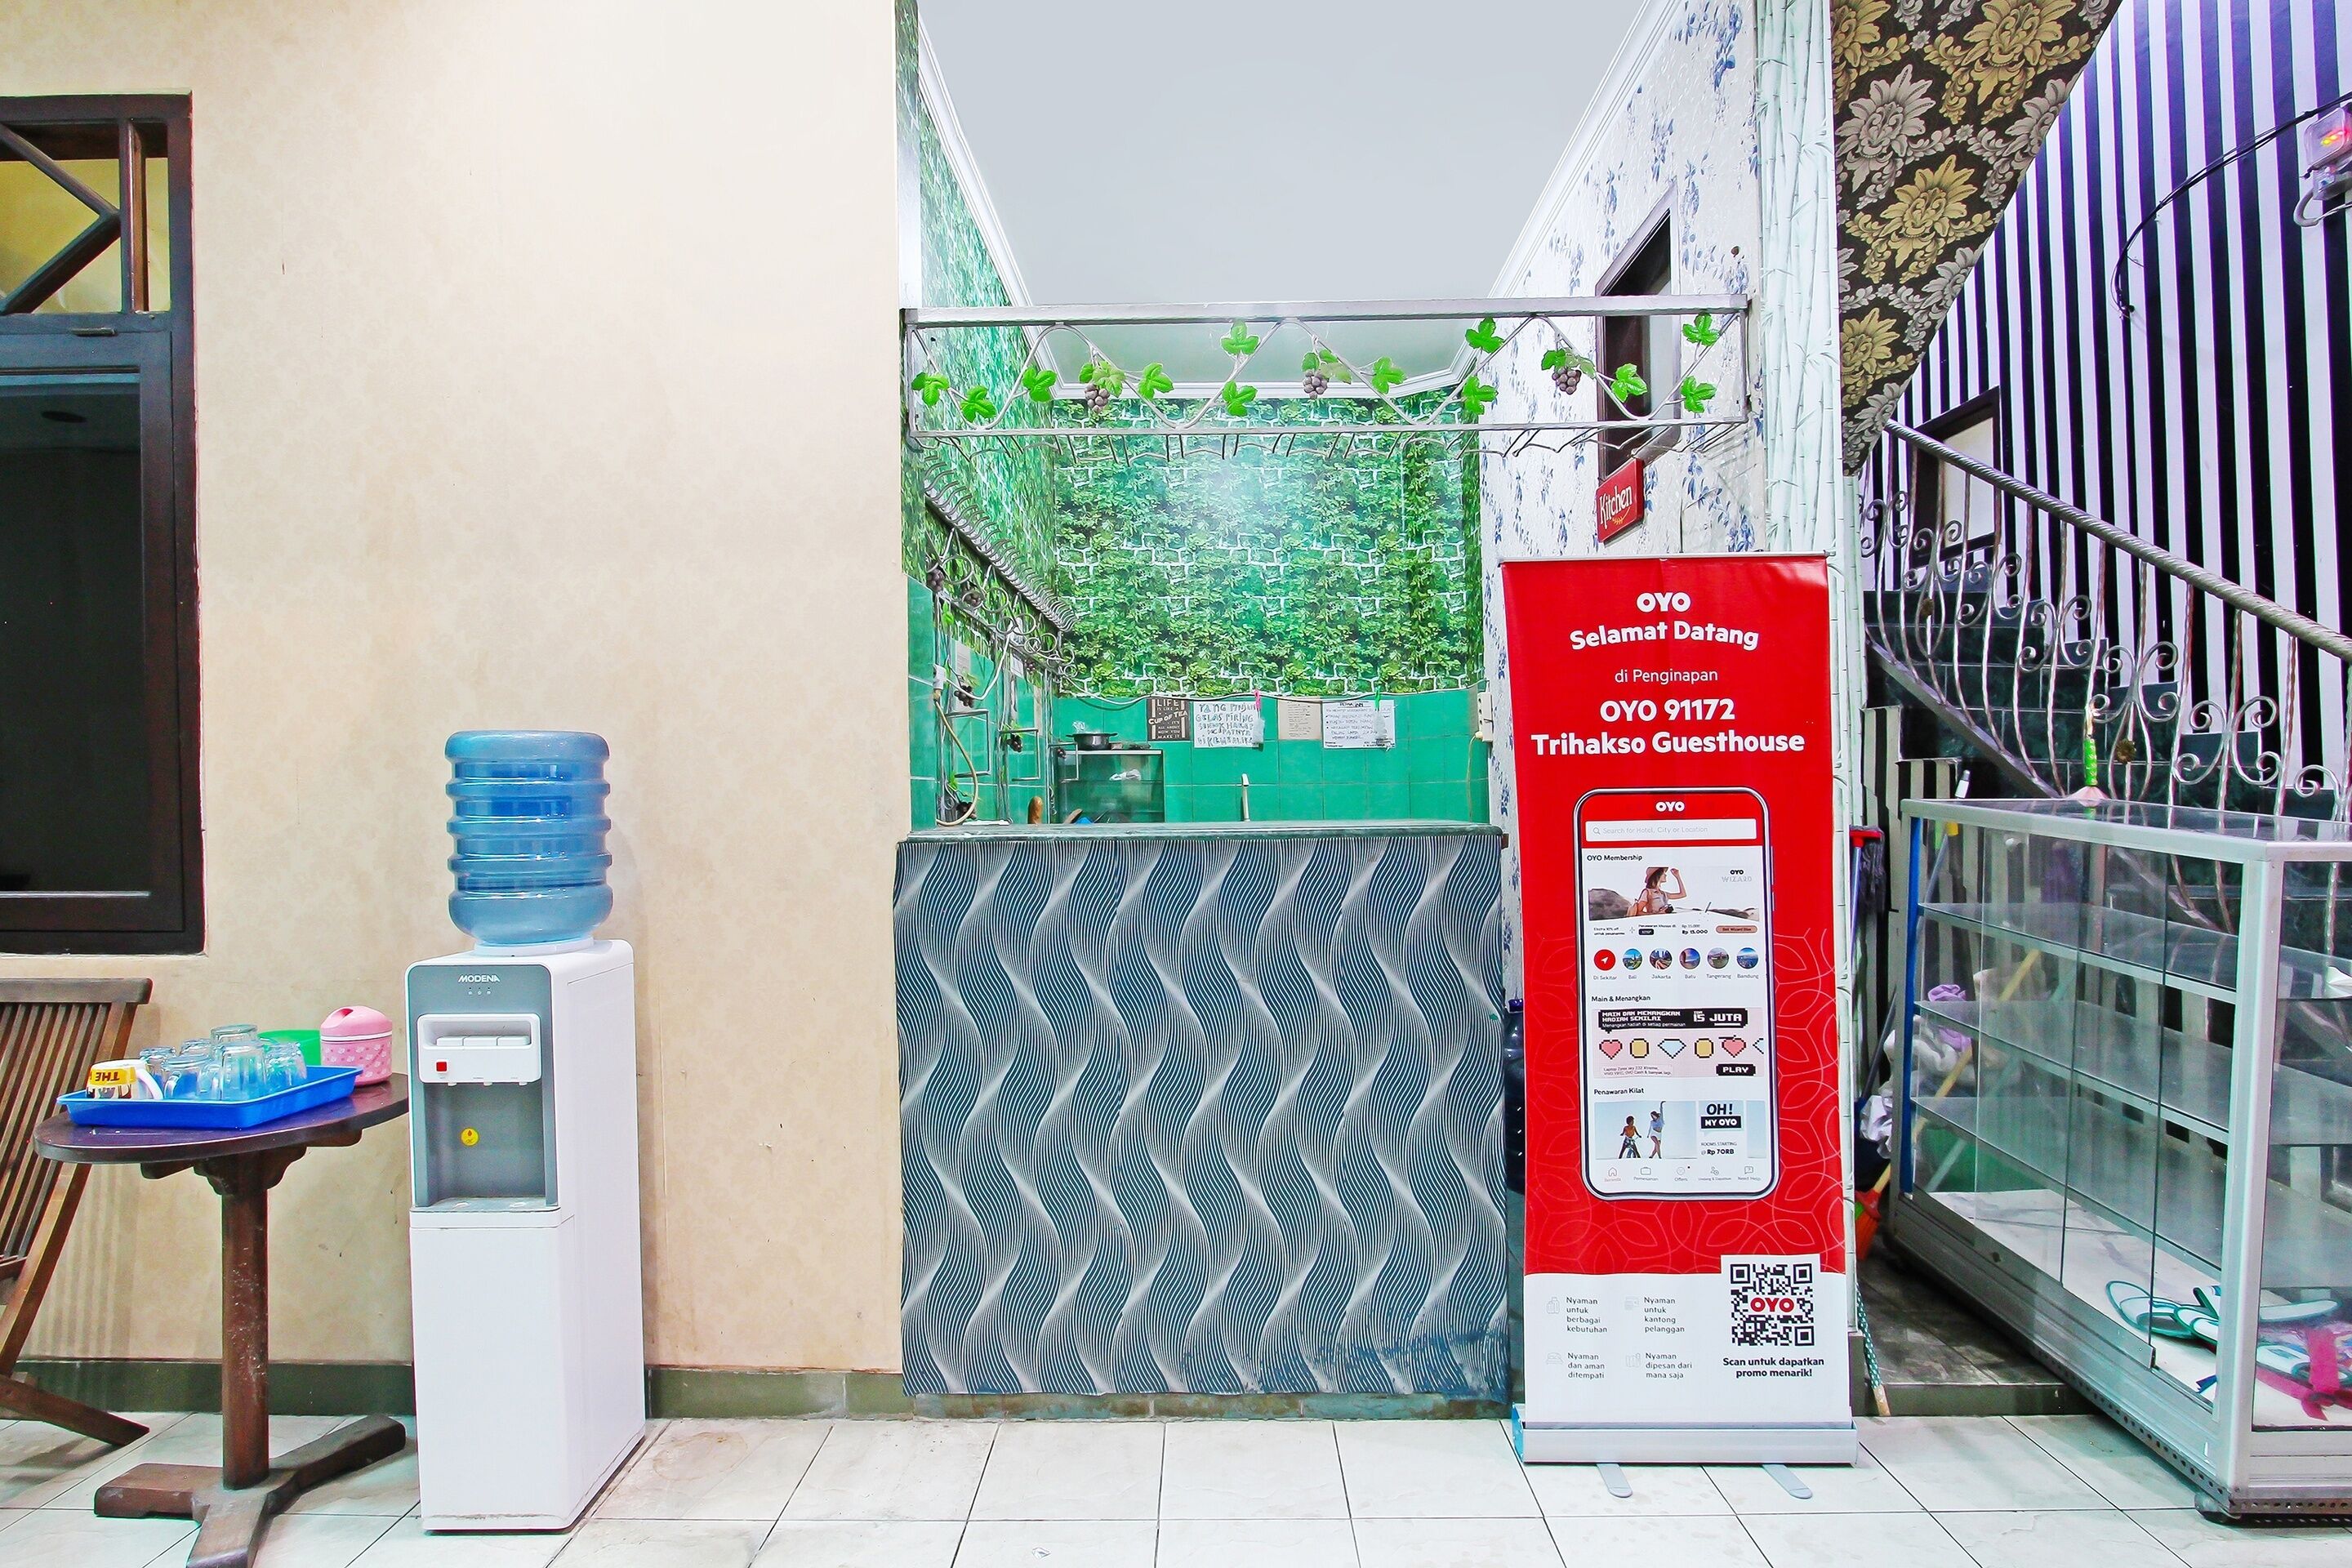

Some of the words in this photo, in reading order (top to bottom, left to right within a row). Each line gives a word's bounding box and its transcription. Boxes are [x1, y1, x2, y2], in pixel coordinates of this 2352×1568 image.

[1600, 485, 1633, 529] Kitchen
[1636, 591, 1691, 612] OYO
[1569, 621, 1668, 650] Selamat
[1673, 620, 1759, 651] Datang
[1615, 669, 1628, 683] di
[1633, 669, 1718, 684] Penginapan
[1600, 700, 1657, 722] OYO
[1664, 697, 1735, 720] 91172
[1530, 733, 1646, 755] Trihakso
[1651, 730, 1806, 754] Guesthouse
[1655, 801, 1686, 812] OYO
[1657, 826, 1671, 835] City
[1604, 854, 1643, 862] Membership
[1615, 995, 1651, 1003] Menangkan
[1708, 1013, 1743, 1022] JUTA
[96, 1071, 120, 1082] THE
[1566, 1297, 1598, 1307] Nyaman
[1643, 1297, 1676, 1306] Nyaman
[1750, 1297, 1795, 1312] OYO
[1566, 1316, 1601, 1325] berbagai
[1645, 1316, 1677, 1325] kantong
[1645, 1326, 1686, 1334] pelanggan
[1567, 1352, 1599, 1362] Nyaman
[1645, 1352, 1677, 1362] Nyaman
[1646, 1362, 1676, 1370] dipesan
[1723, 1357, 1746, 1366] Scan
[1748, 1357, 1777, 1365] untuk
[1779, 1357, 1824, 1368] dapatkan
[1568, 1372, 1605, 1380] ditempati
[1668, 1372, 1684, 1380] saja
[1735, 1370, 1767, 1379] promo
[1769, 1369, 1813, 1377] menarik!
